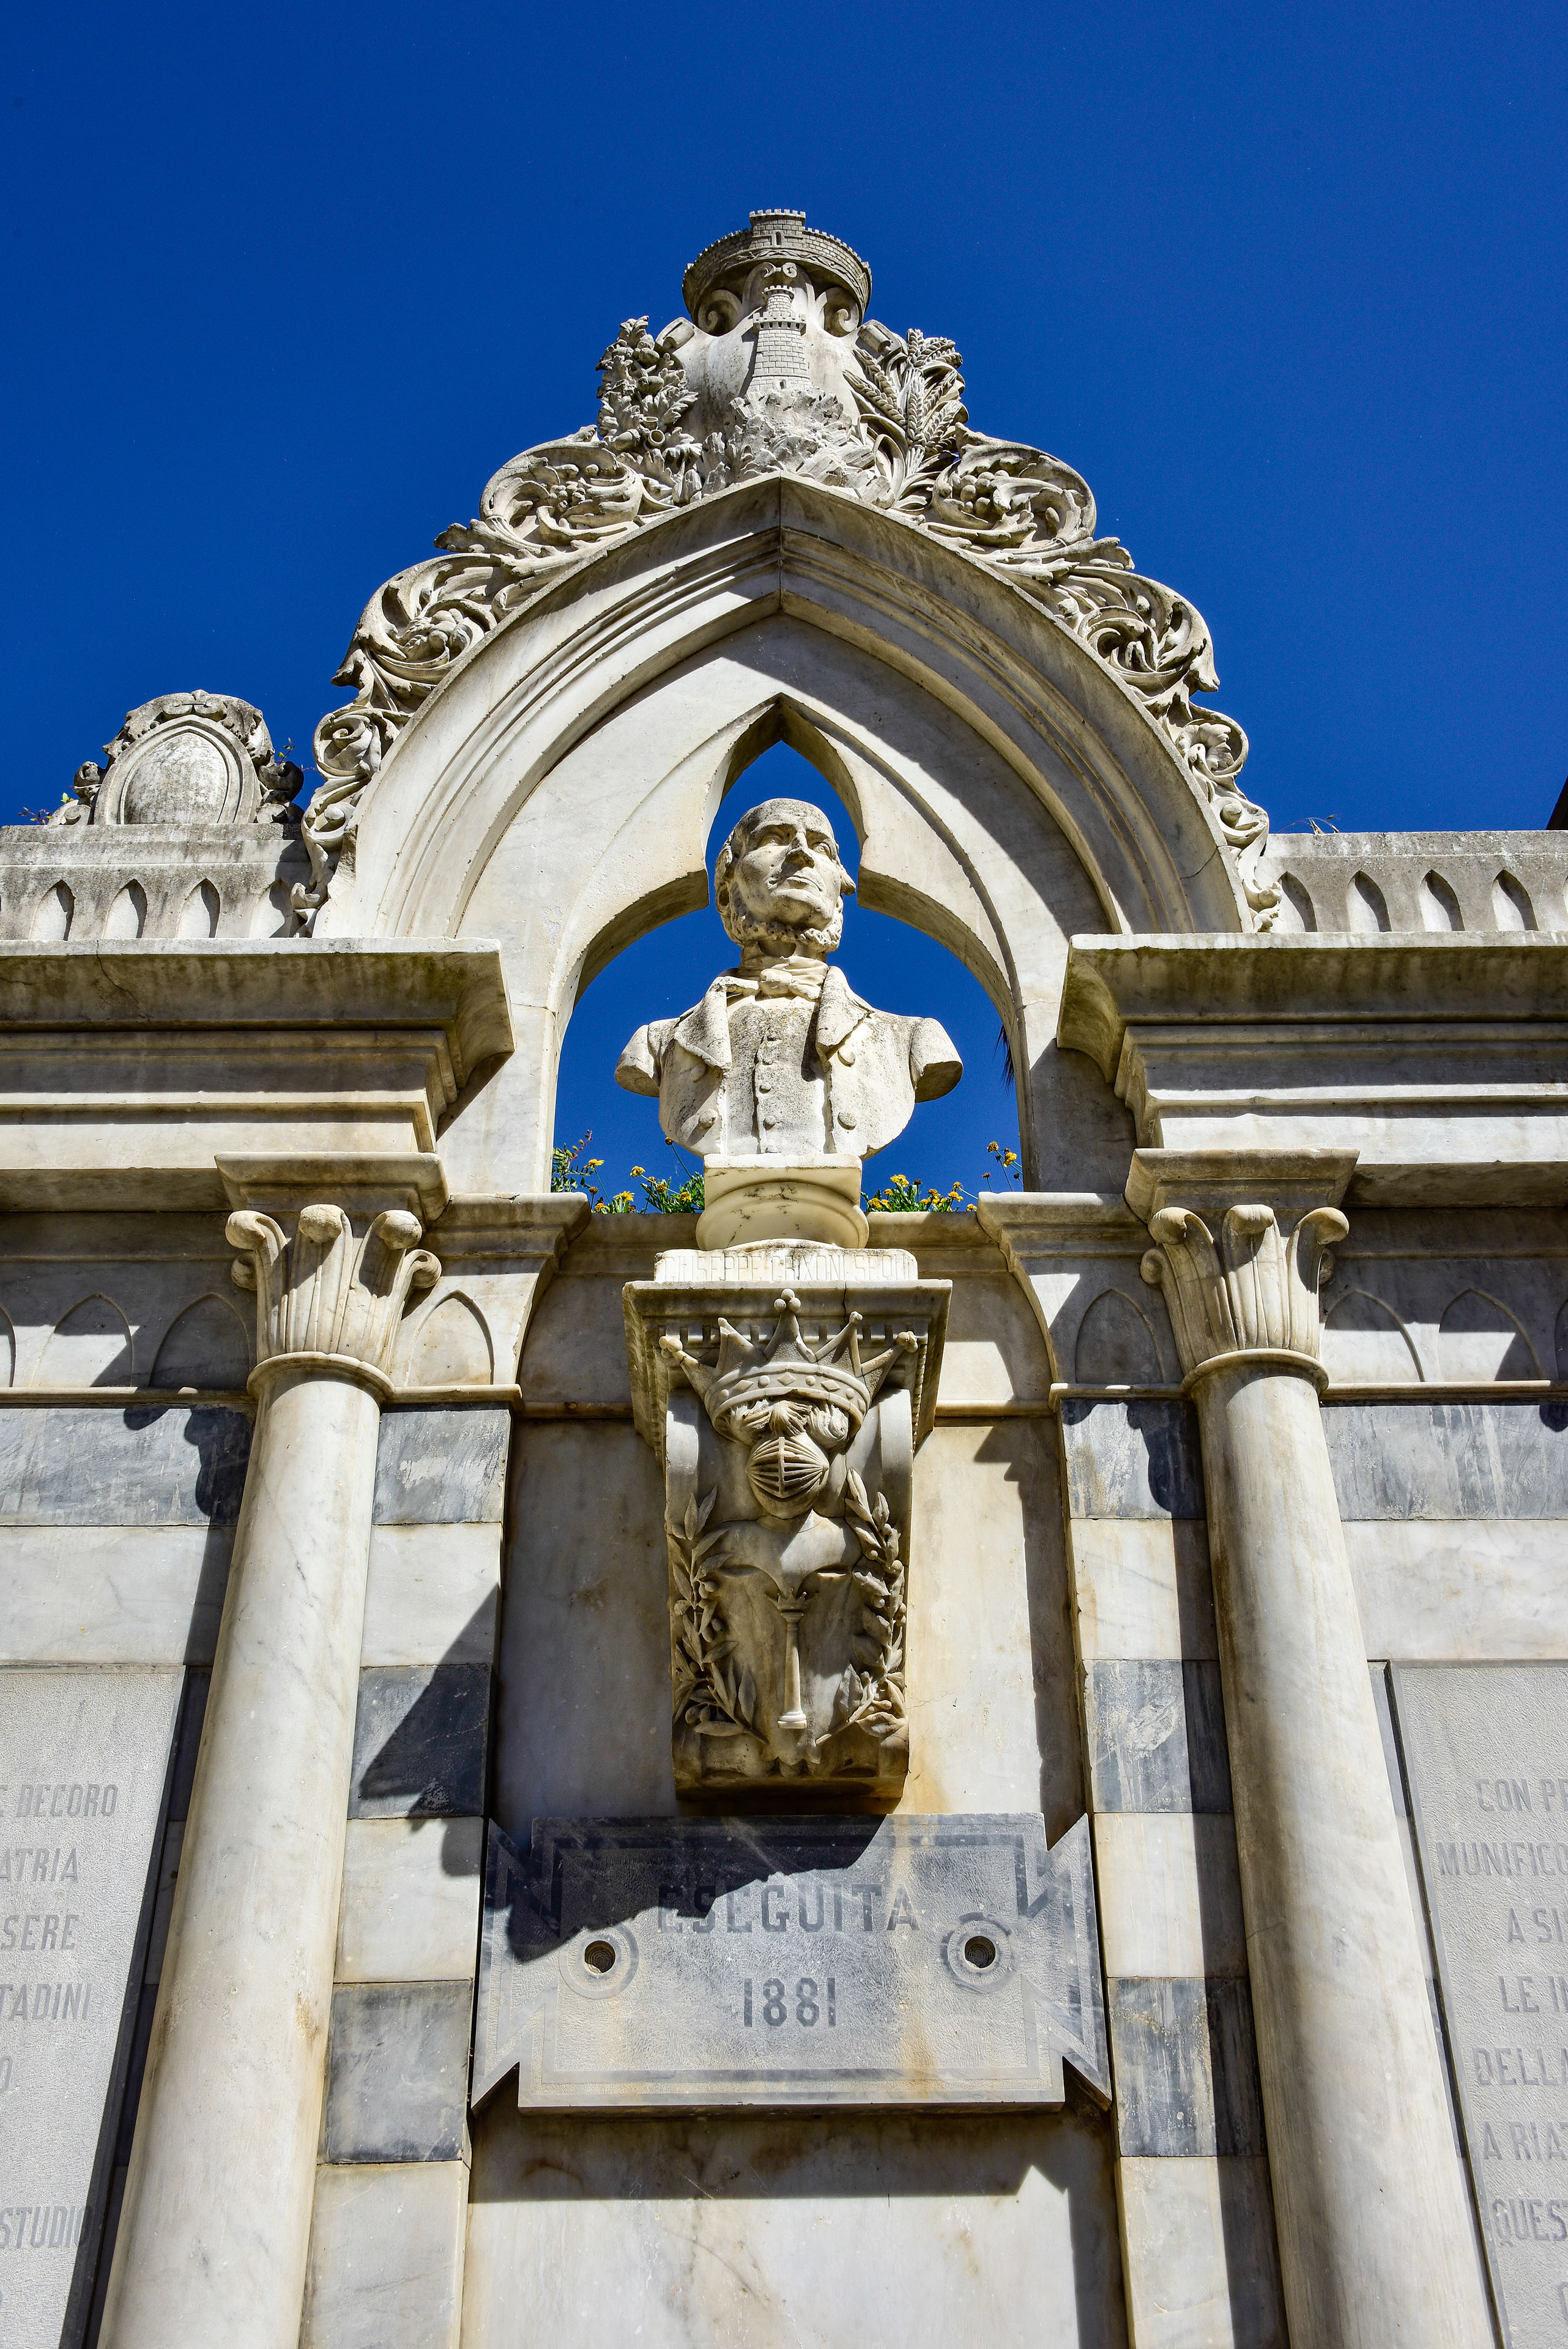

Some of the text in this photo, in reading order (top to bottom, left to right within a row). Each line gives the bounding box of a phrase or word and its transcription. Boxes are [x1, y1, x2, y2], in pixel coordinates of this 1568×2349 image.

[17, 1783, 119, 1817] DECORO
[1476, 1778, 1533, 1812] CON
[657, 1883, 920, 1932] ESEGUITA
[1507, 1907, 1568, 1943] A SI
[1, 1913, 80, 1950] SERE
[743, 1977, 836, 2027] 1881
[1499, 1975, 1540, 2013] LE
[1483, 2120, 1503, 2160] A
